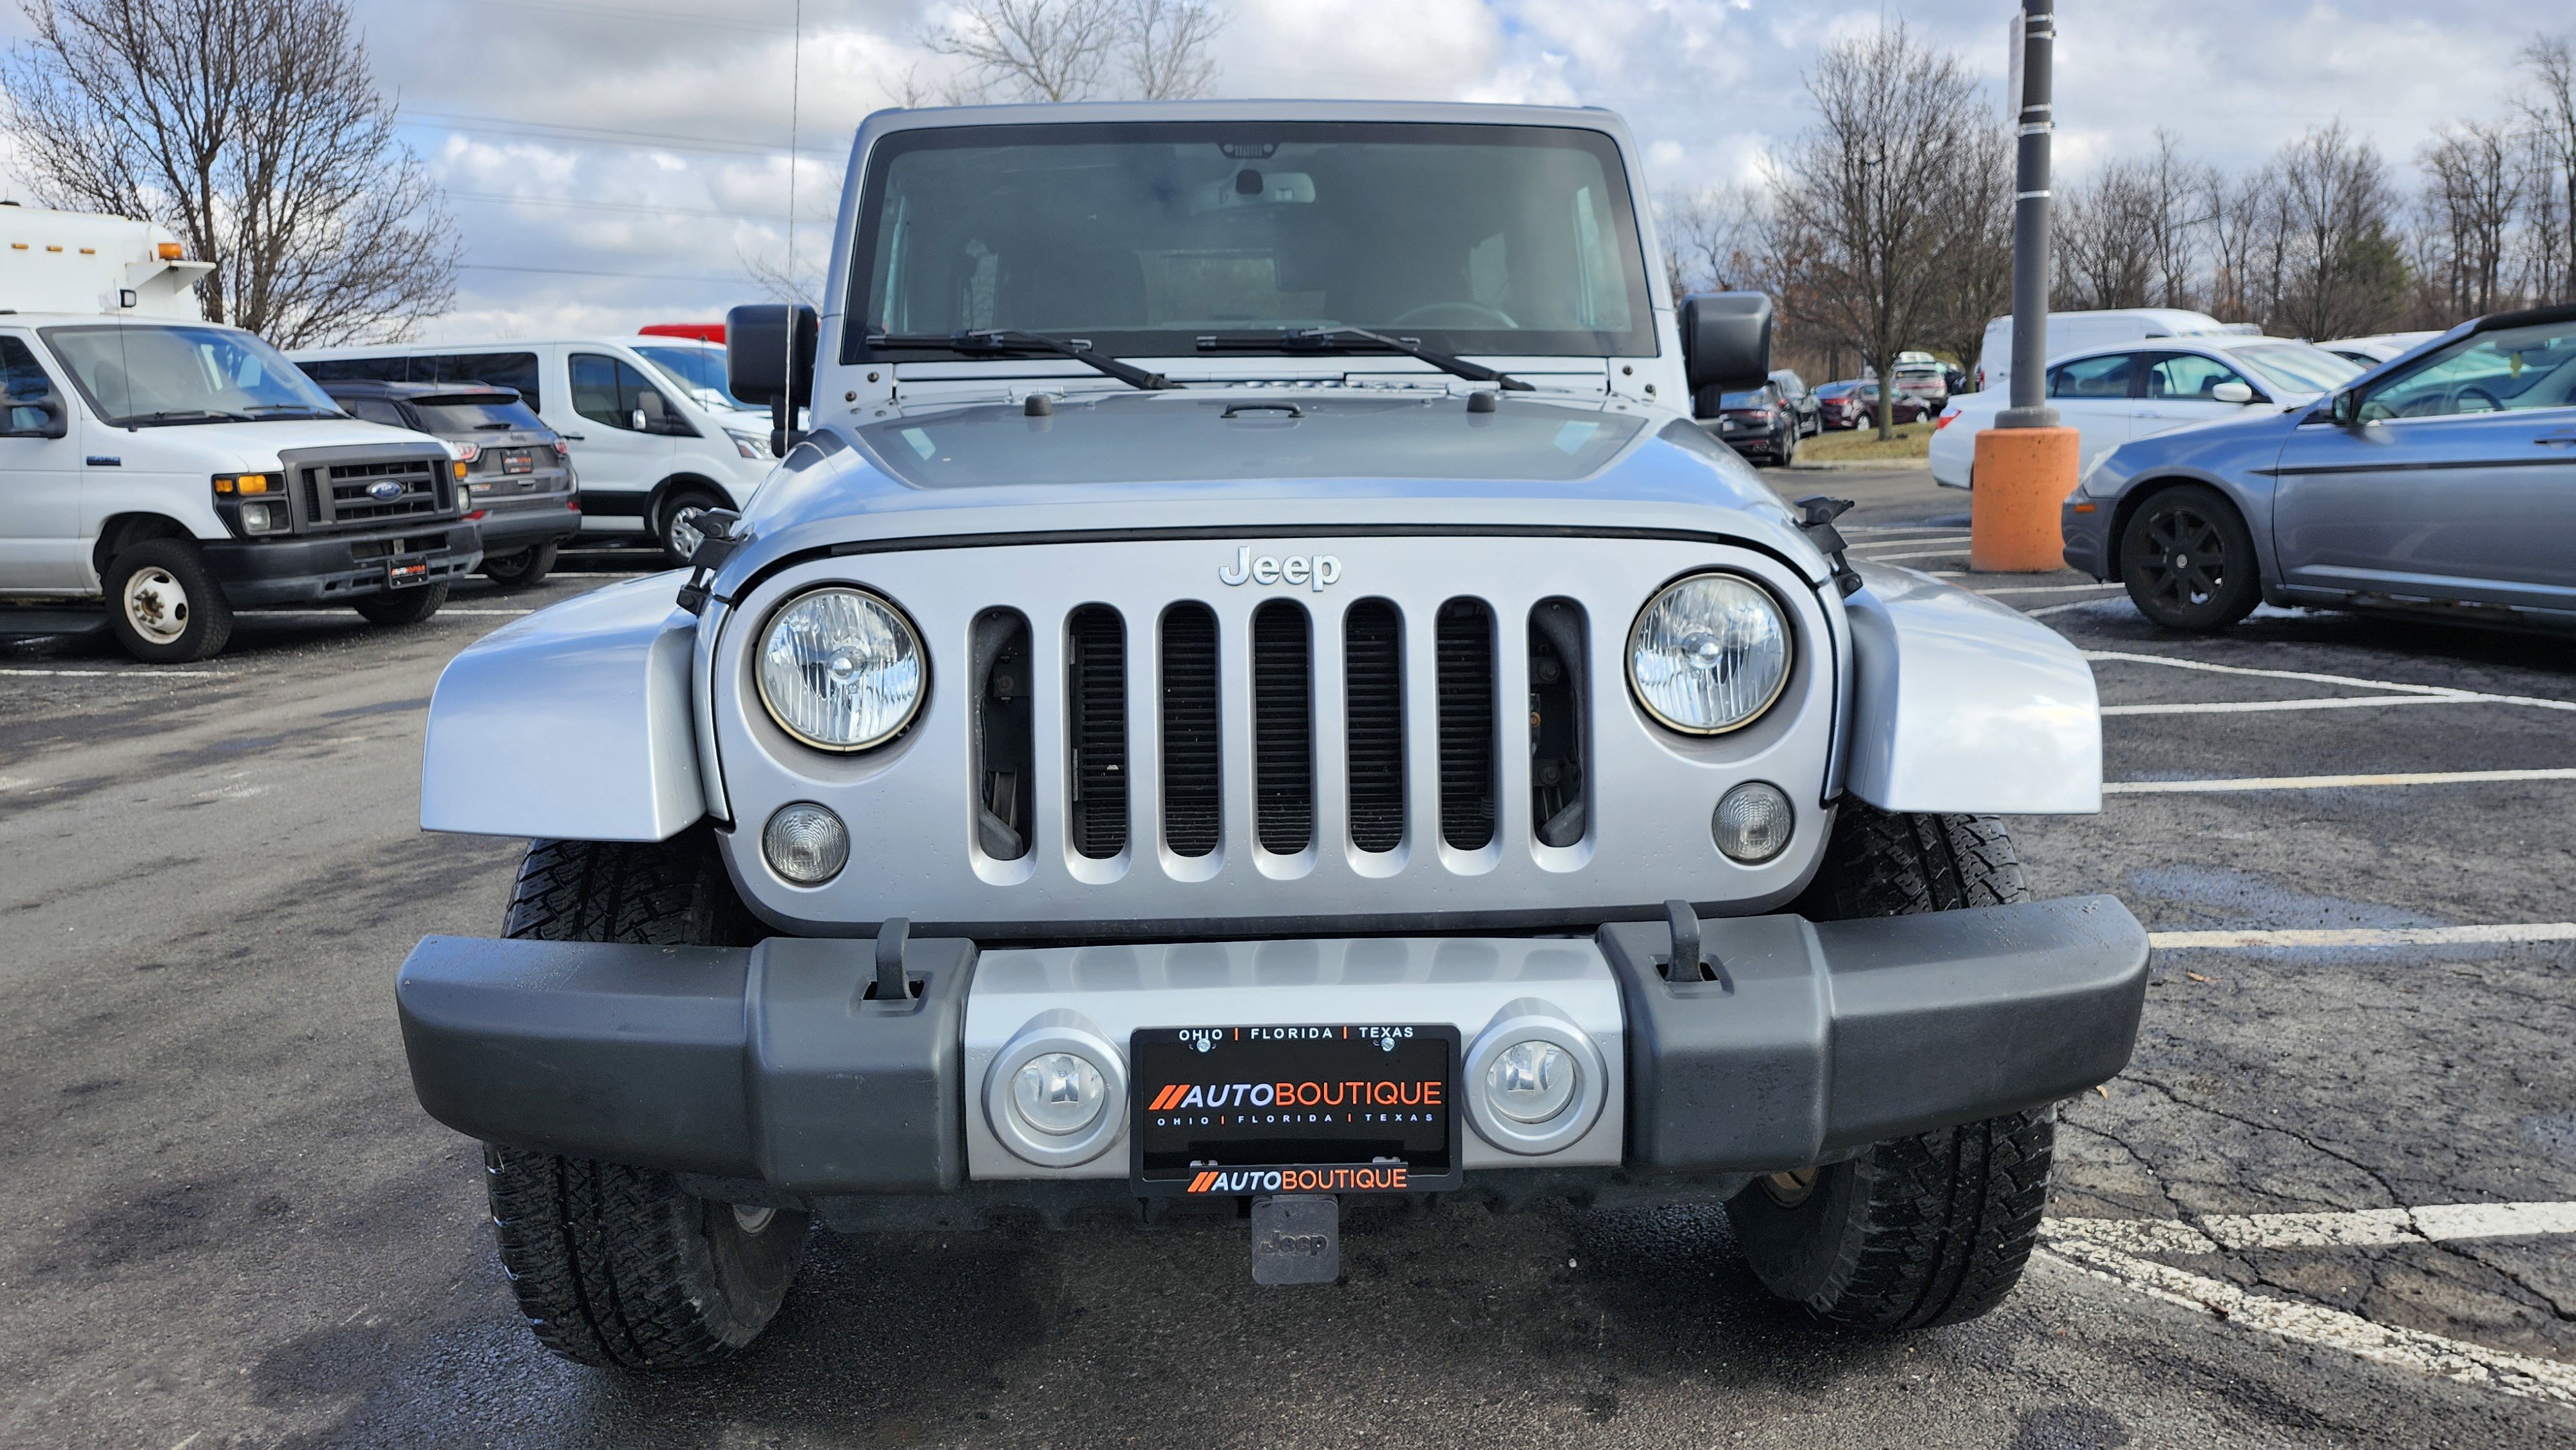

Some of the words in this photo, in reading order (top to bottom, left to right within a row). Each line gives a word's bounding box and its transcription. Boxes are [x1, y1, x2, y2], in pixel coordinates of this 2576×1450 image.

[1218, 545, 1341, 592] Jeep
[1179, 1029, 1223, 1040] OHIO
[1251, 1028, 1333, 1039] FLORIDA
[1359, 1026, 1414, 1038] TEXAS
[1157, 1117, 1209, 1126] OHIO
[1238, 1115, 1333, 1123] FLORIDA
[1261, 1230, 1328, 1256] Jeep
